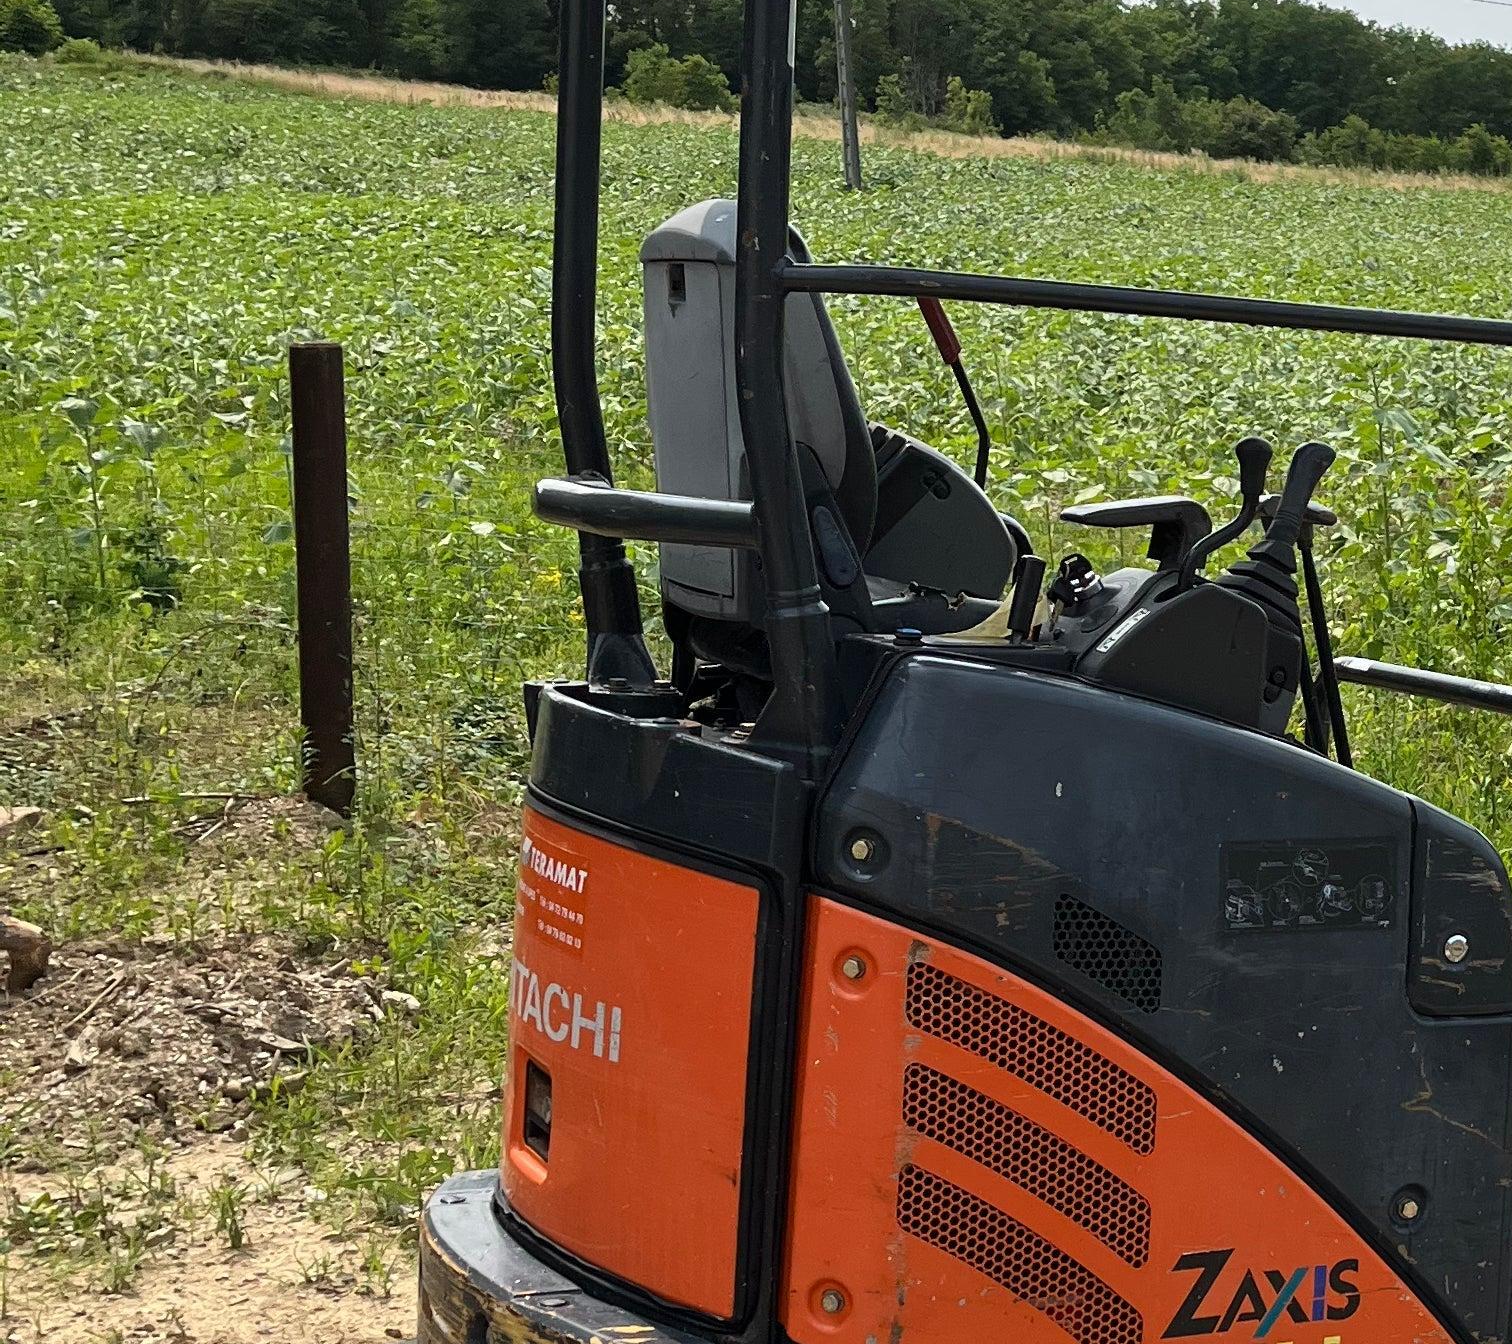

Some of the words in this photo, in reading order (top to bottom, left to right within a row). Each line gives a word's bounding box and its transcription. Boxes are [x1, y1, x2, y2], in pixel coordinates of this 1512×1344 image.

[530, 846, 588, 894] TERAMAT
[511, 957, 622, 1063] ITACHI
[1160, 1248, 1361, 1340] ZAXIS
